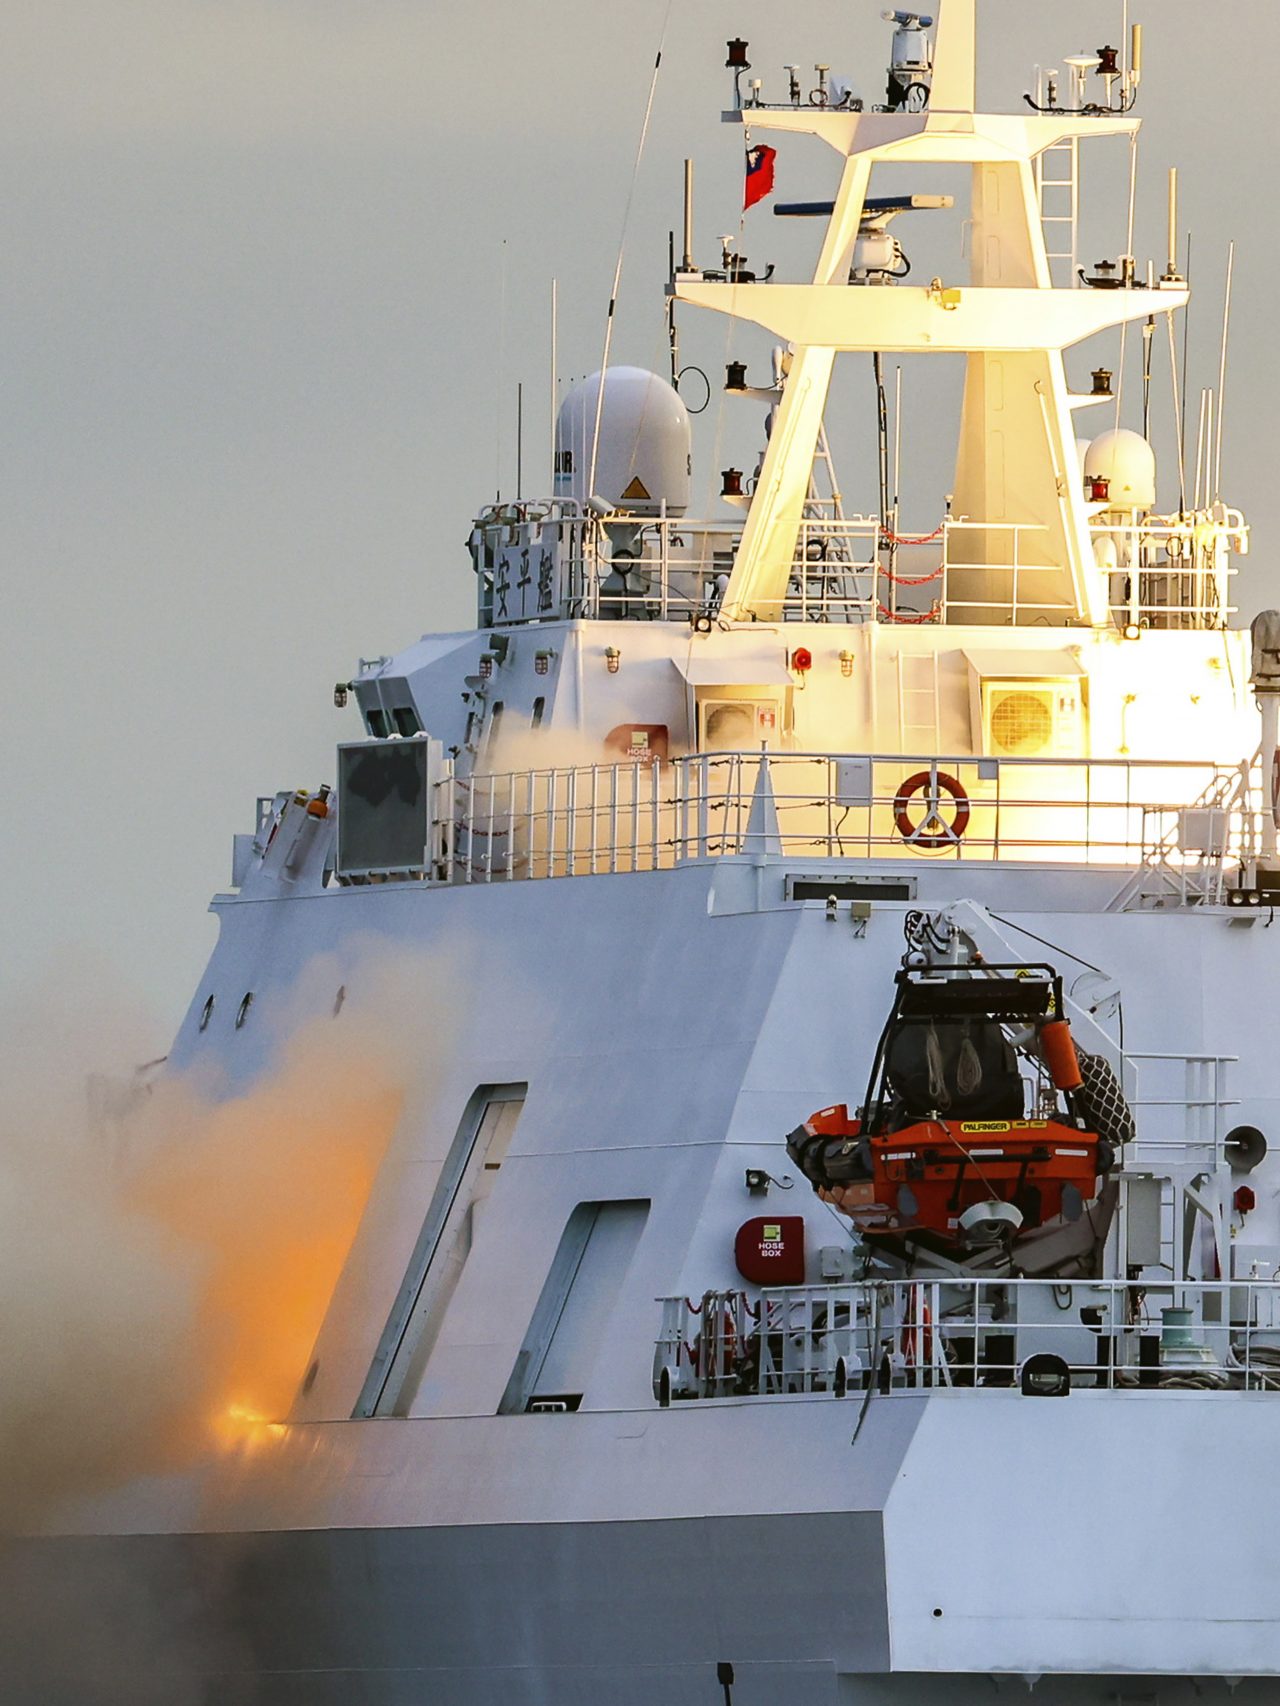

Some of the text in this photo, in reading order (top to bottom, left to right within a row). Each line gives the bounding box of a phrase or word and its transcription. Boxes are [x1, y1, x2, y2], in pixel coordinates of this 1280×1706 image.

[627, 748, 651, 756] HOSE
[963, 1122, 1008, 1131] PALFINGER
[758, 1242, 785, 1250] HOSE
